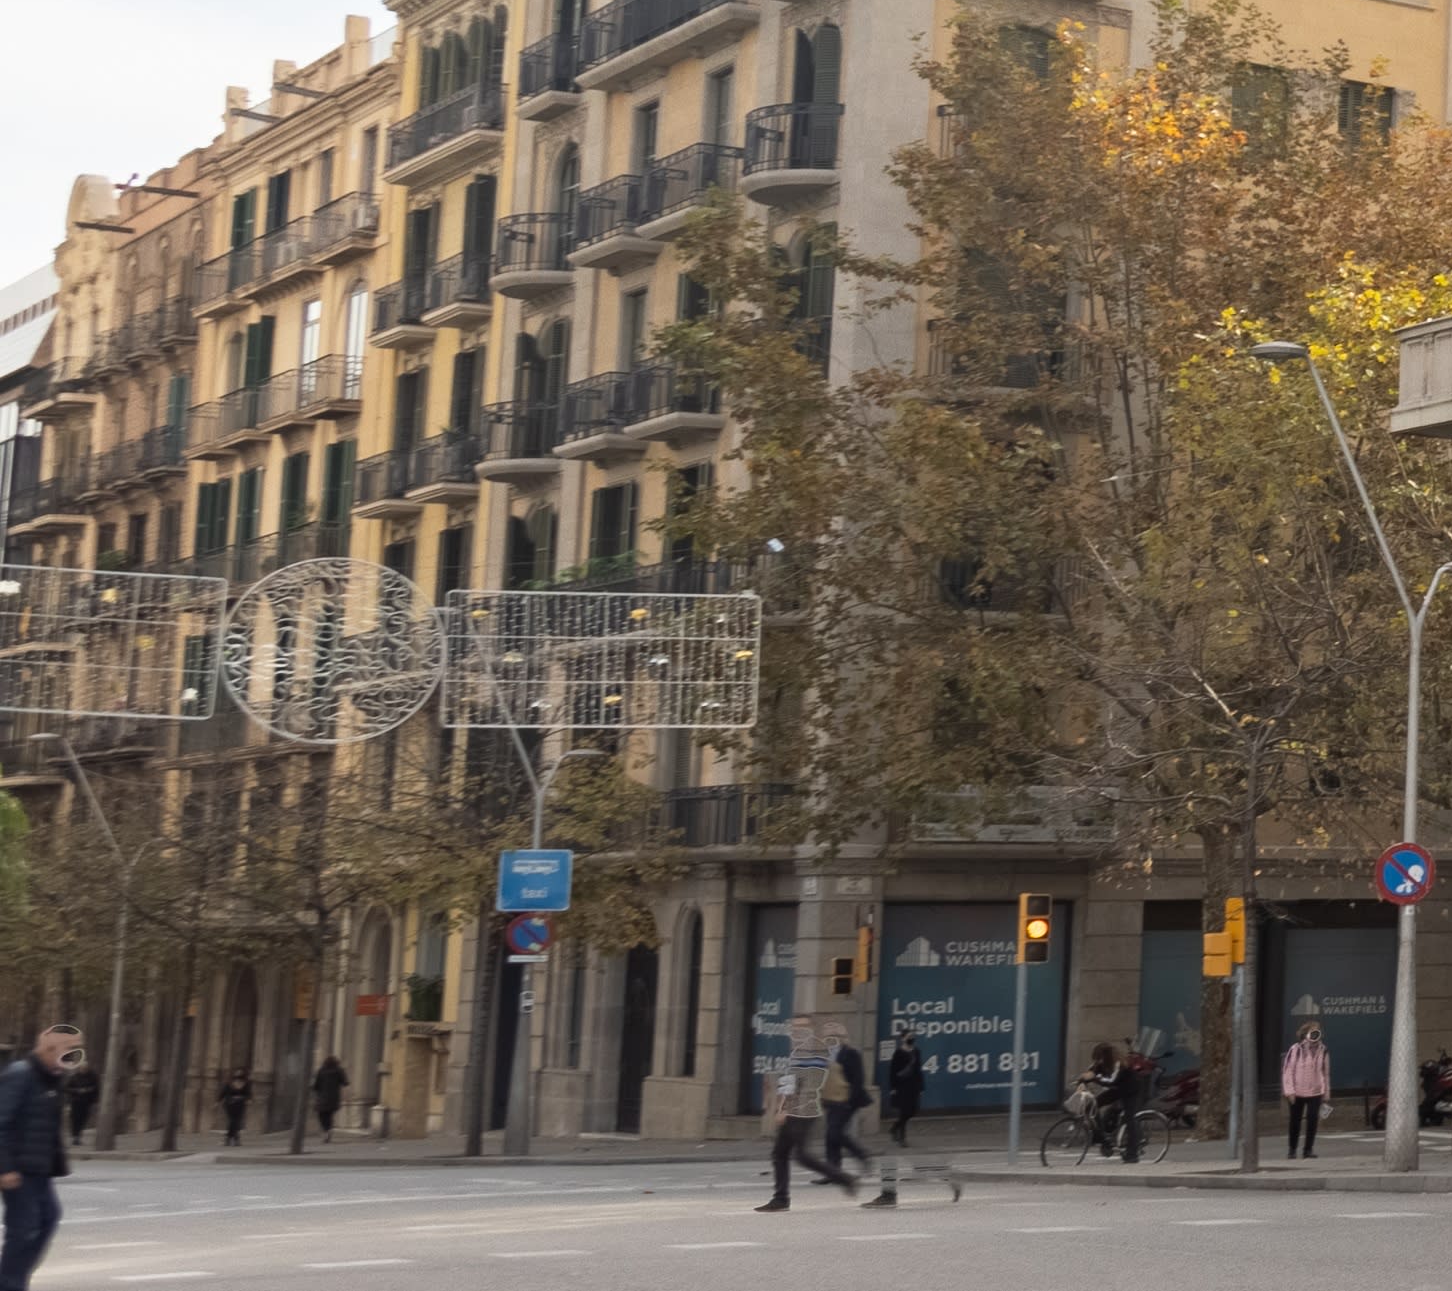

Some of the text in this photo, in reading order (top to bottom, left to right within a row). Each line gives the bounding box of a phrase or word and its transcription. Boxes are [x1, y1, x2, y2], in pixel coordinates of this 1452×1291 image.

[945, 941, 1016, 953] CUSHMA
[945, 954, 1020, 966] WAKEFI
[892, 996, 954, 1016] Local
[1322, 997, 1377, 1005] CUSHMAN
[1322, 1006, 1387, 1015] WAKEFIELD
[891, 1016, 1013, 1037] Disponible
[947, 1053, 989, 1073] 881
